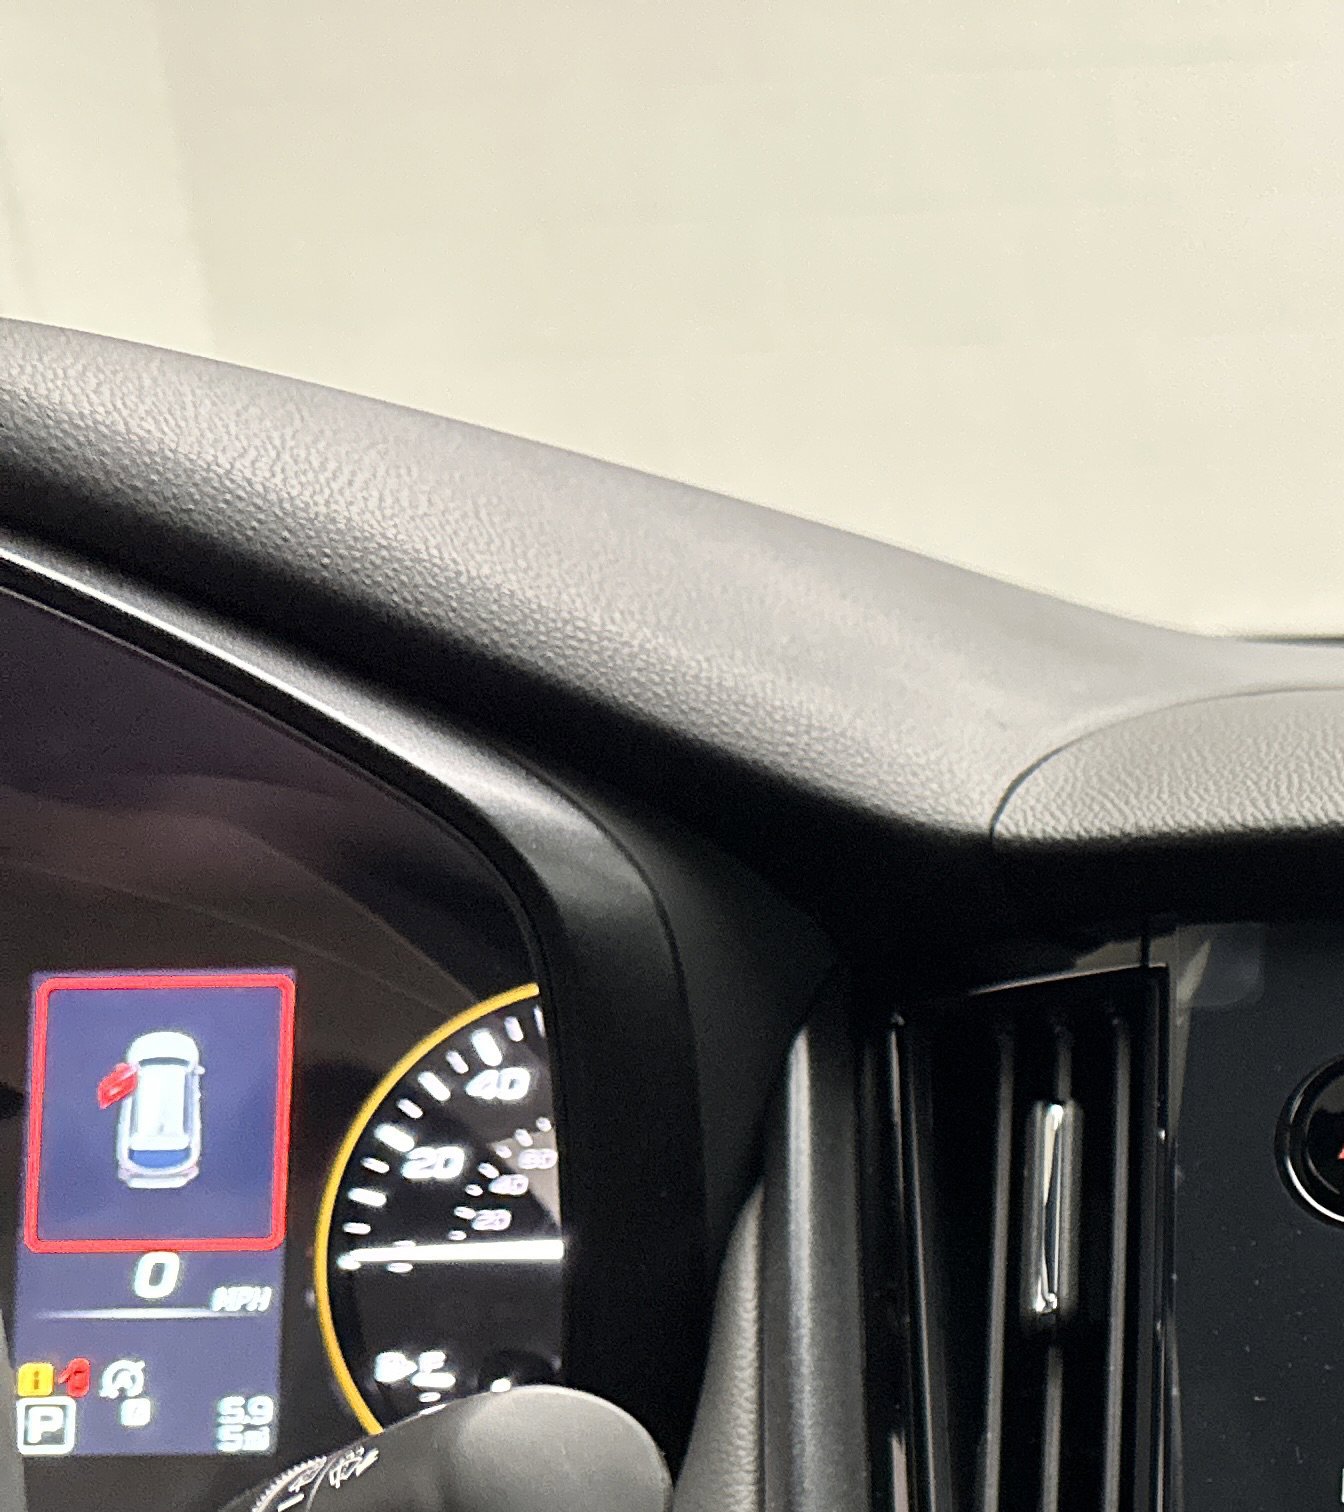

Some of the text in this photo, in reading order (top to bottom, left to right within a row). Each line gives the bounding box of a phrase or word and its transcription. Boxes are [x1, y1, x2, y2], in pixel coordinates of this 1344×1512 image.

[465, 1067, 531, 1101] 40
[402, 1146, 466, 1180] 20
[210, 1287, 272, 1312] MPH
[27, 1406, 64, 1444] P
